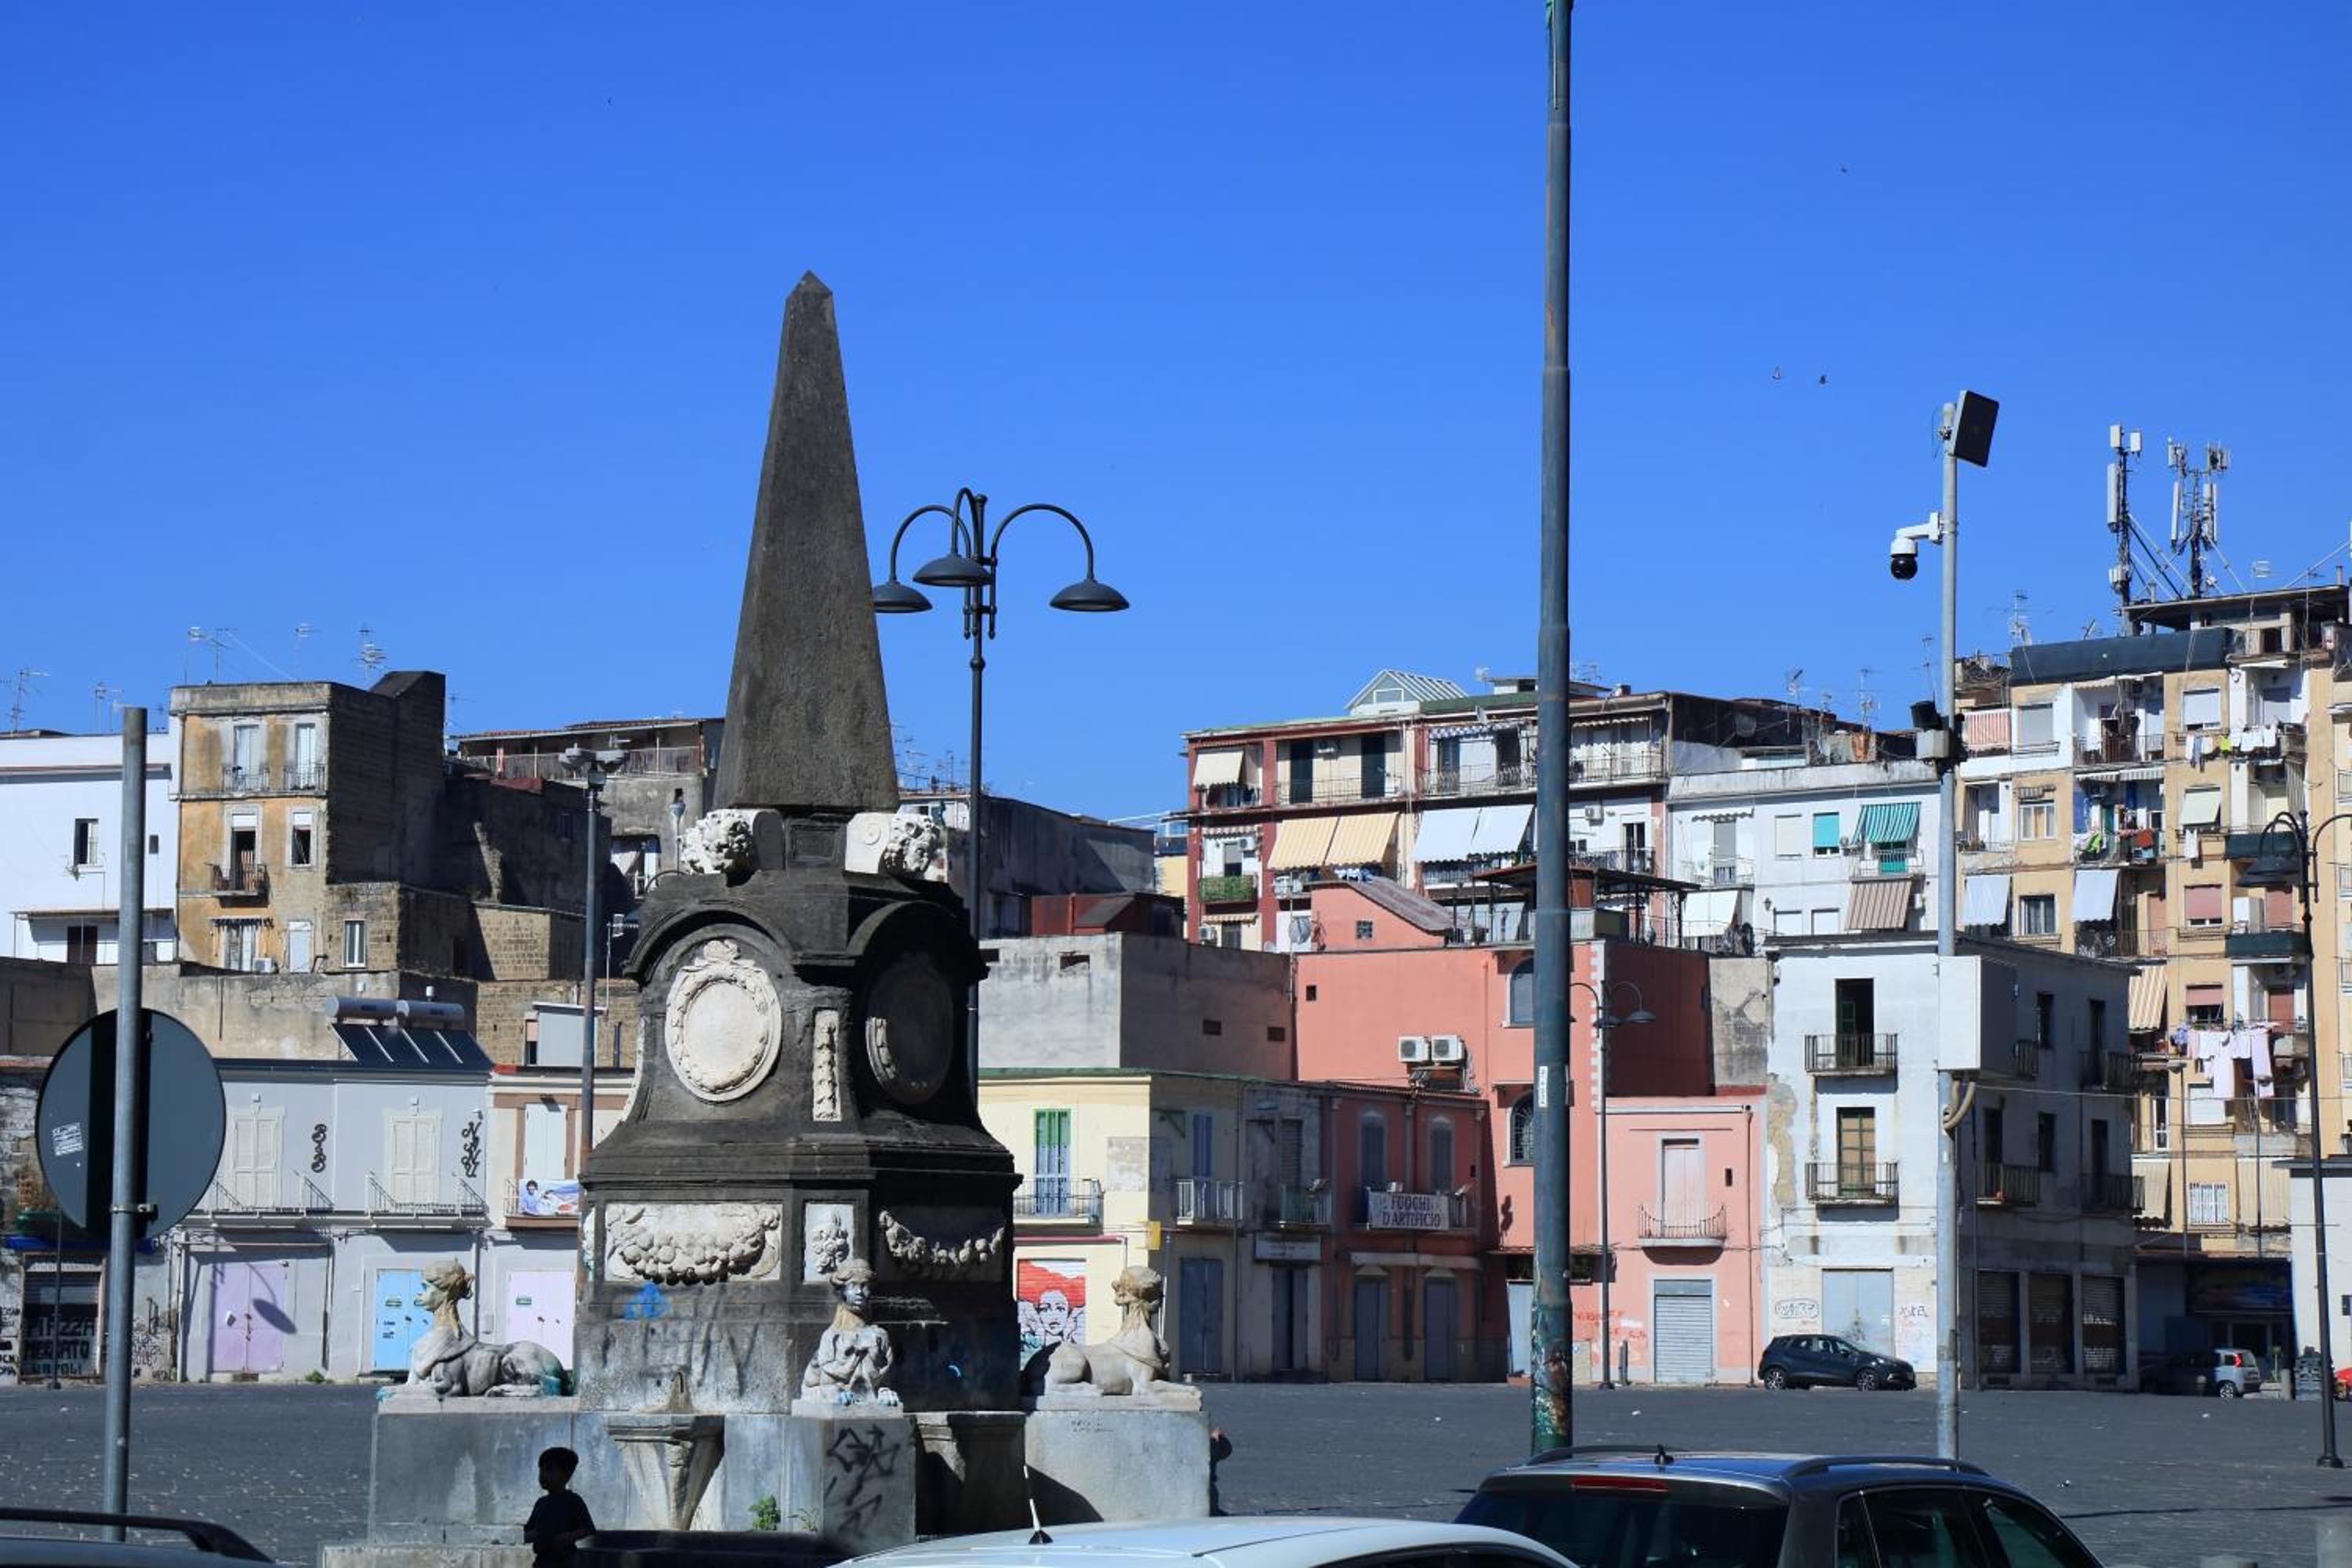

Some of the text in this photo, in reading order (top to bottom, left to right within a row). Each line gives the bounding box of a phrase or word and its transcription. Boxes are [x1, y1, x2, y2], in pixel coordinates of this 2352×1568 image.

[311, 1123, 327, 1173] B&B
[1392, 1196, 1431, 1211] FUOCHI
[24, 1341, 90, 1359] MERATO
